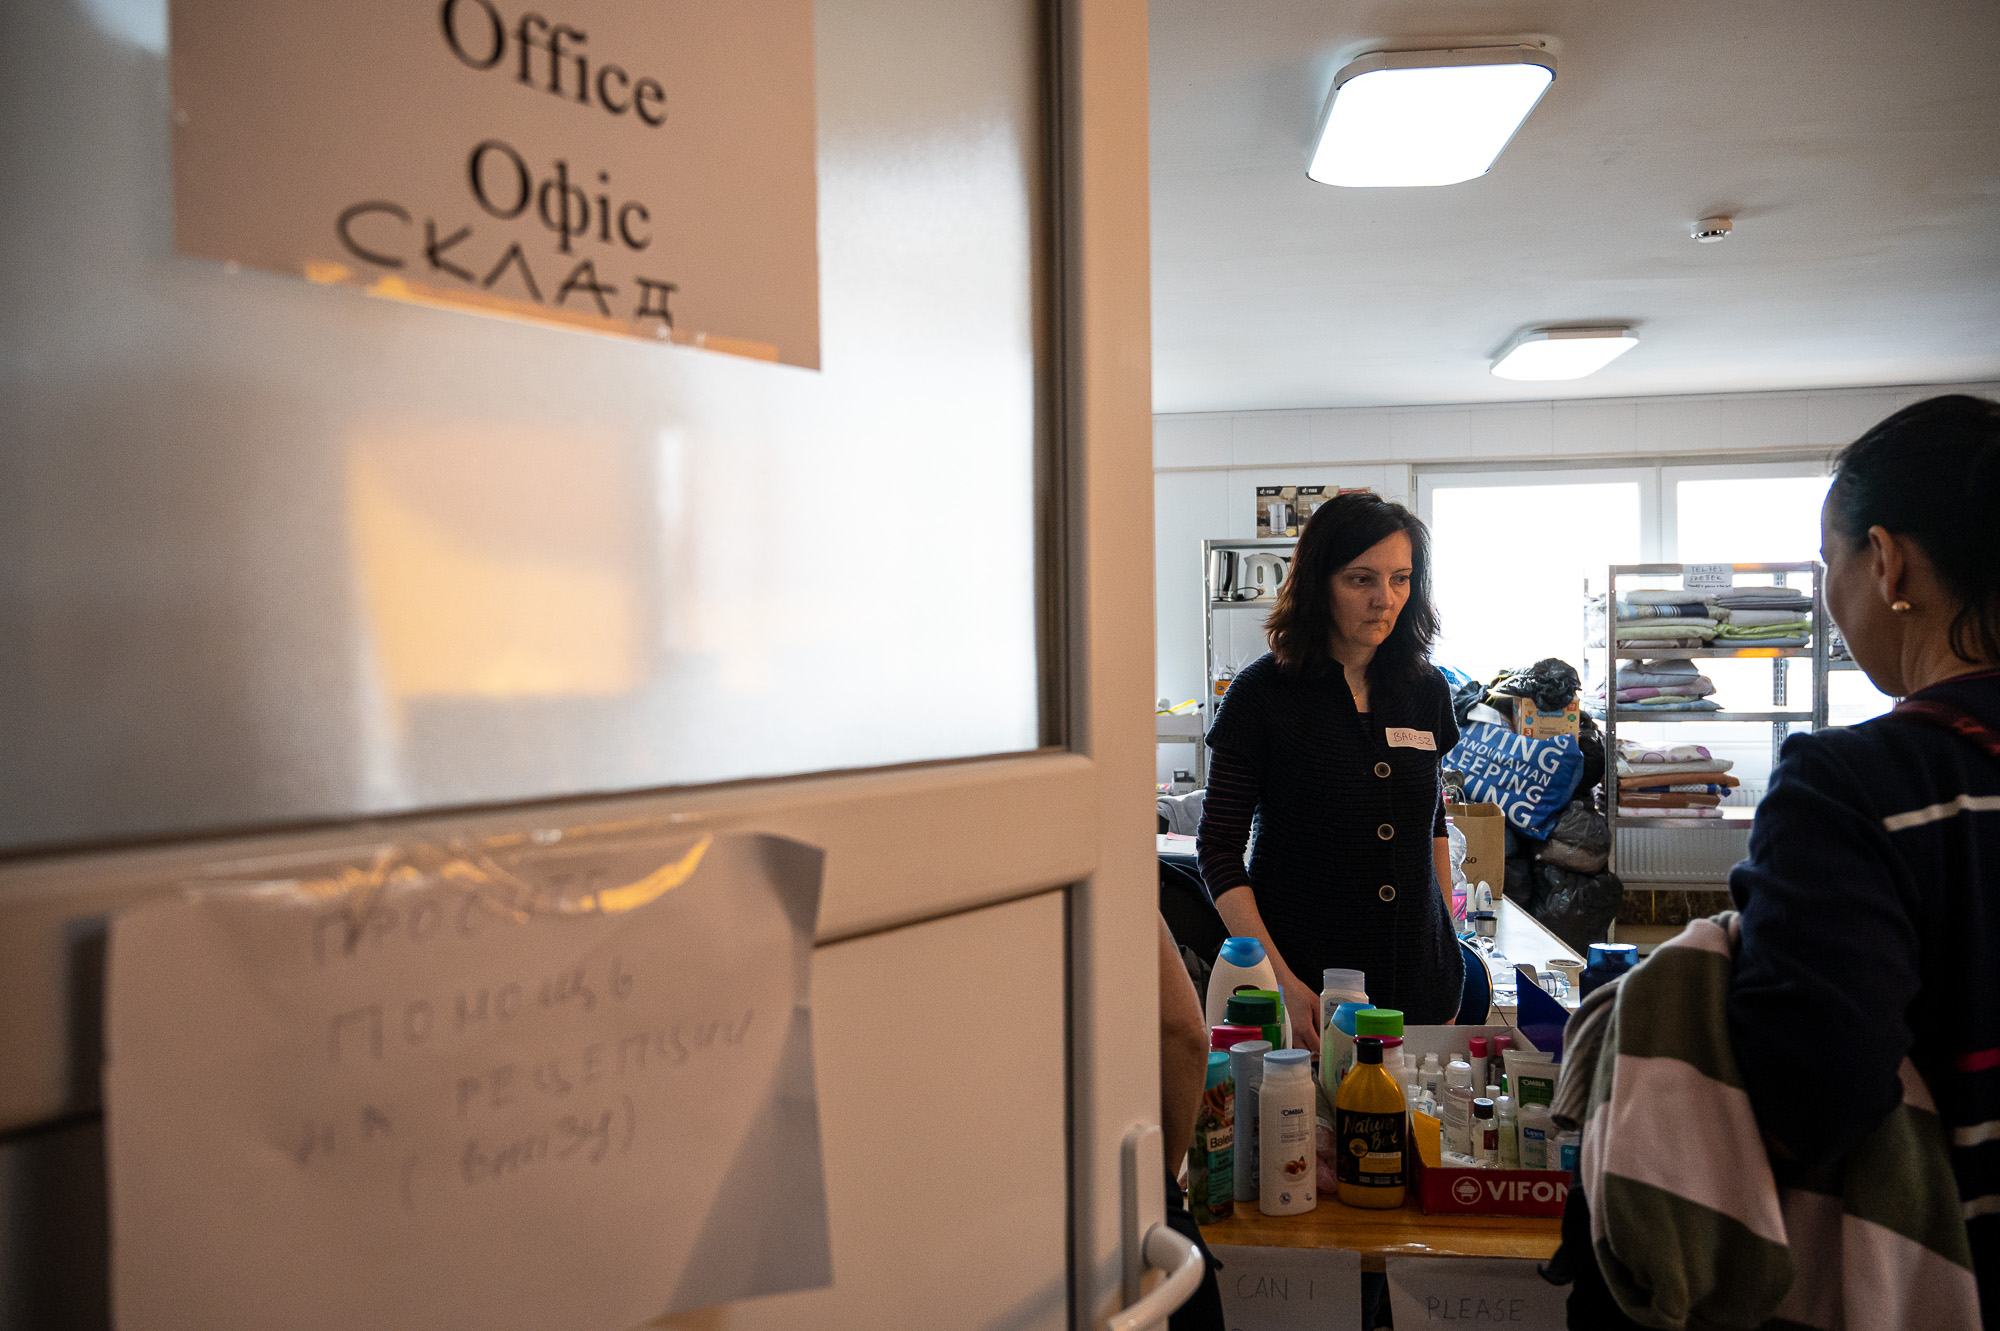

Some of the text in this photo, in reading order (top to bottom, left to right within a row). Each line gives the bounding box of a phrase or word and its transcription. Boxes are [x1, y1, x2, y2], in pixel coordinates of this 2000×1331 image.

[440, 0, 668, 127] Office
[467, 139, 654, 256] Офіс
[336, 200, 680, 328] СКЛАД
[1457, 736, 1552, 787] ANDINAVIAN
[1460, 722, 1564, 775] IVING
[1343, 1114, 1395, 1136] Nature
[1210, 1133, 1234, 1149] Balea
[1371, 1130, 1398, 1151] Box
[1486, 1180, 1569, 1202] VIFON
[1236, 1274, 1289, 1301] CAN
[1427, 1296, 1525, 1323] PLEASE
